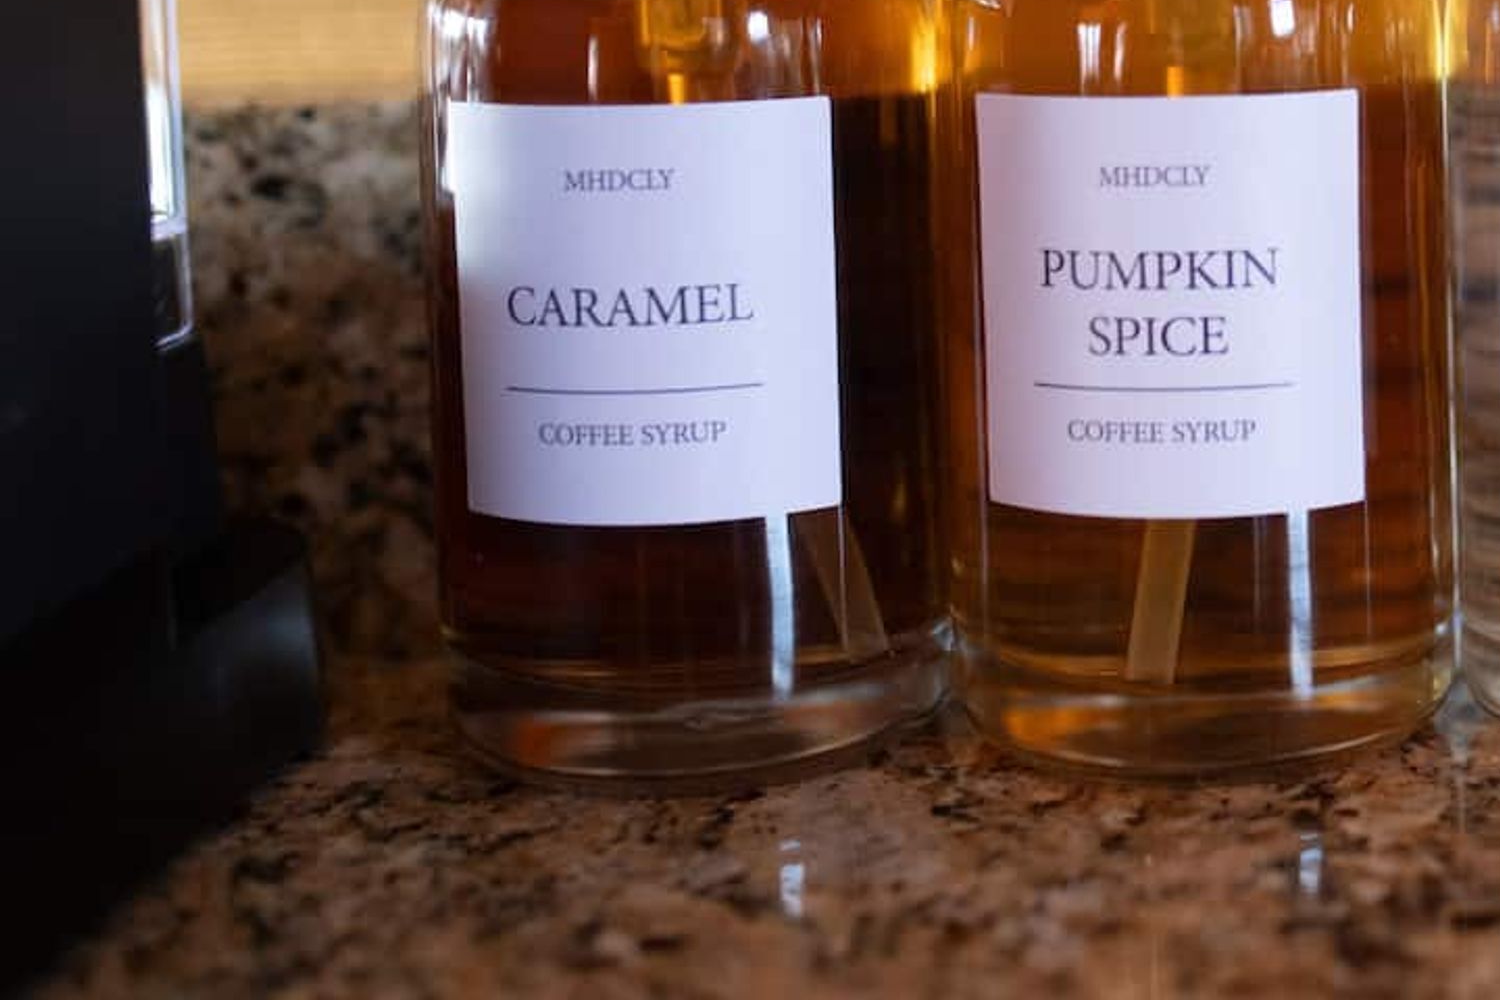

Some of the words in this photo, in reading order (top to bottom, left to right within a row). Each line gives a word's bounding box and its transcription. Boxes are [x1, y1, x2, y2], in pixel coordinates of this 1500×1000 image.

[564, 167, 675, 193] MHDCLY
[1099, 164, 1211, 188] MHDCLY
[1041, 247, 1280, 291] PUMPKIN
[507, 282, 754, 328] CARAMEL
[1089, 316, 1229, 357] SPICE
[538, 423, 635, 447] COFFEE
[640, 420, 727, 446] SYRUP
[1067, 420, 1164, 444] COFFEE
[1171, 418, 1257, 444] SYRUP
